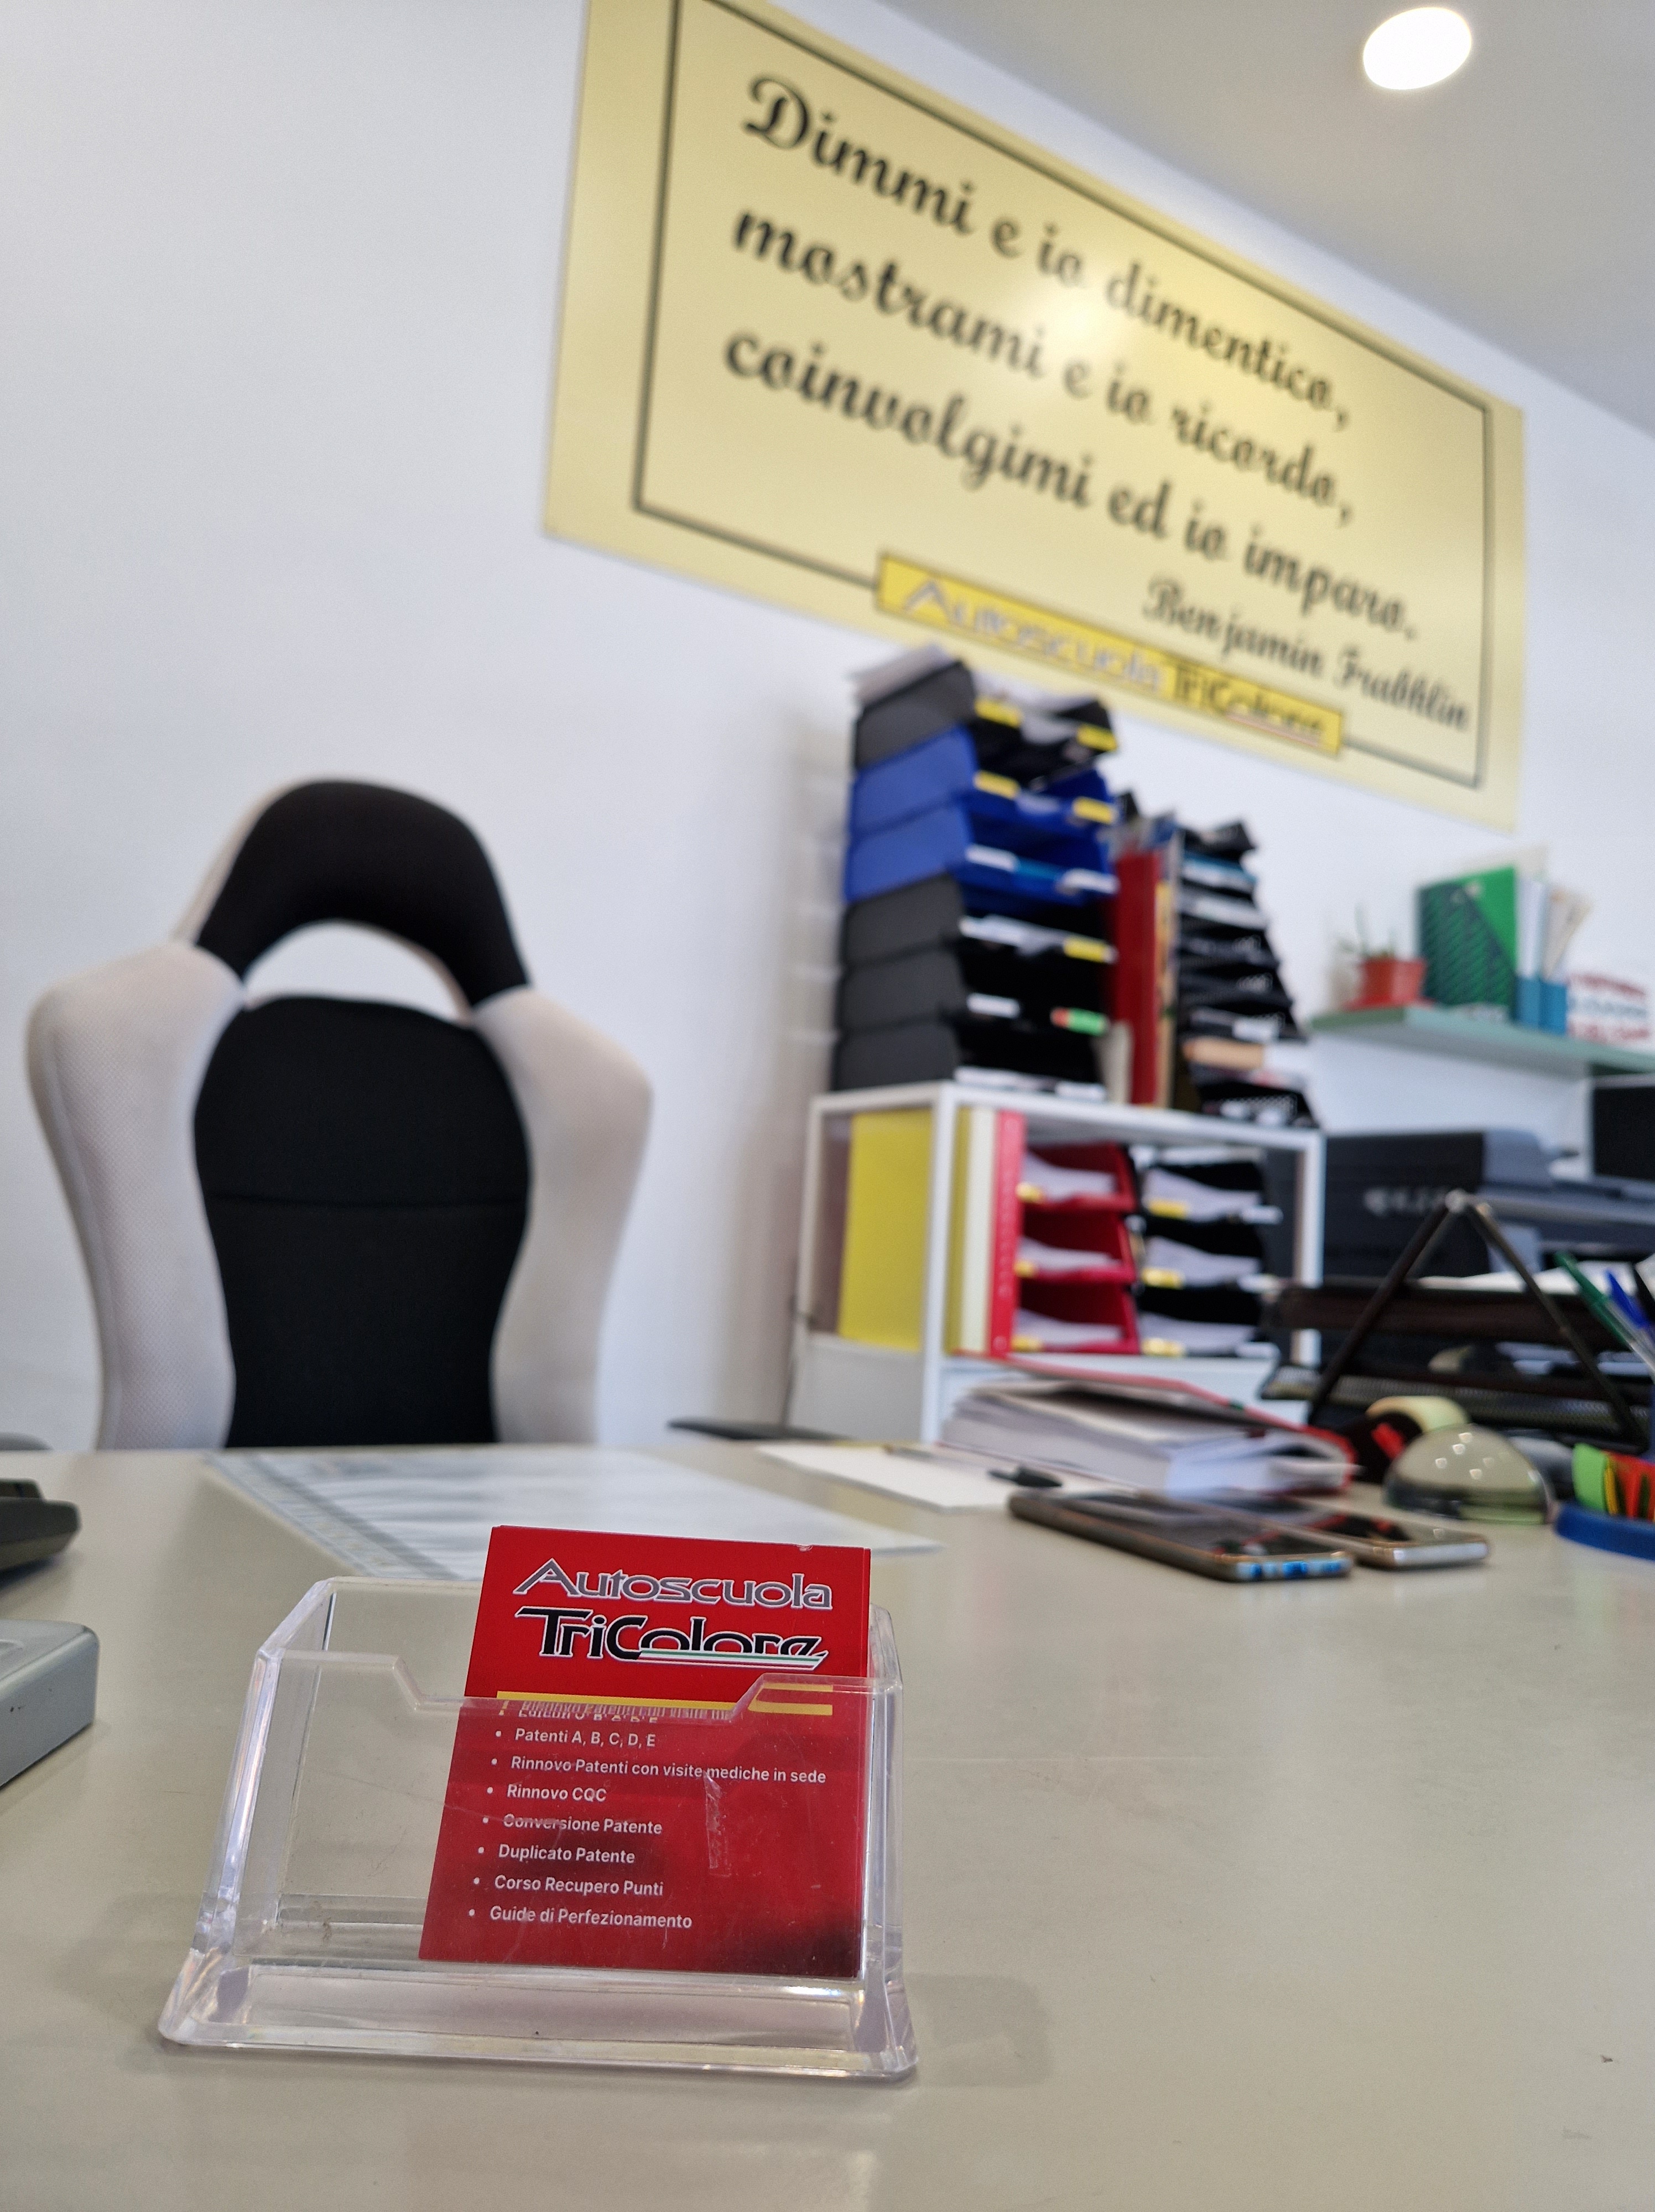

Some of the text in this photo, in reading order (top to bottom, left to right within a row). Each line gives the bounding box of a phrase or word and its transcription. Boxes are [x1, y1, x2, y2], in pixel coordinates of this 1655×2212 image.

[742, 74, 1350, 430] Dimmi e io dimentico,
[731, 207, 1352, 528] mostrami e io ricordo,
[724, 331, 1418, 641] coinvolgimi ed io imparo.
[1144, 576, 1325, 678] Benjamin
[512, 1558, 833, 1610] Autoscuola
[514, 1606, 830, 1671] TriColore
[515, 1728, 656, 1749] Patenti A, B, C, D, E
[511, 1756, 826, 1783] Rinnovo Patenti con visite mediche in sede
[507, 1783, 607, 1802] Rinnovo CQC
[503, 1813, 663, 1834] Conversione Patente
[498, 1844, 635, 1864] Duplicato Patente
[495, 1874, 663, 1896] Corso Recupero Punti
[490, 1905, 693, 1929] Guide di Perfezionamento
